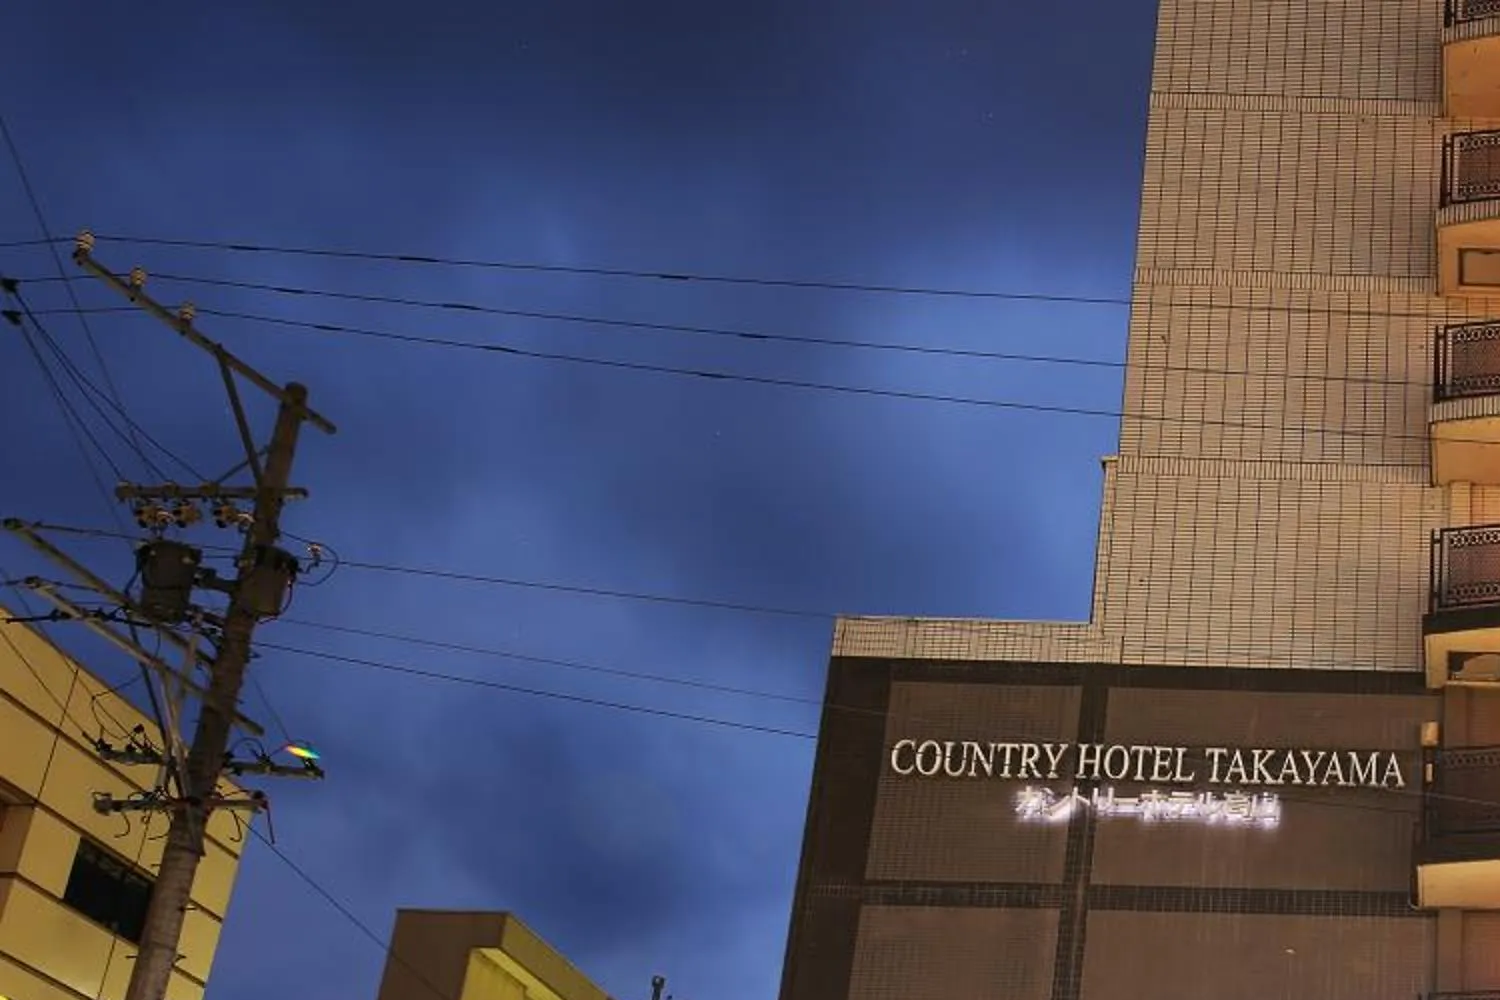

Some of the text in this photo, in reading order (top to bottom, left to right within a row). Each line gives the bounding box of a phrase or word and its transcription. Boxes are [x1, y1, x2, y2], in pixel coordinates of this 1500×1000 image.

[890, 739, 1405, 788] COUNTRY HOTEL TAKAYAMA
